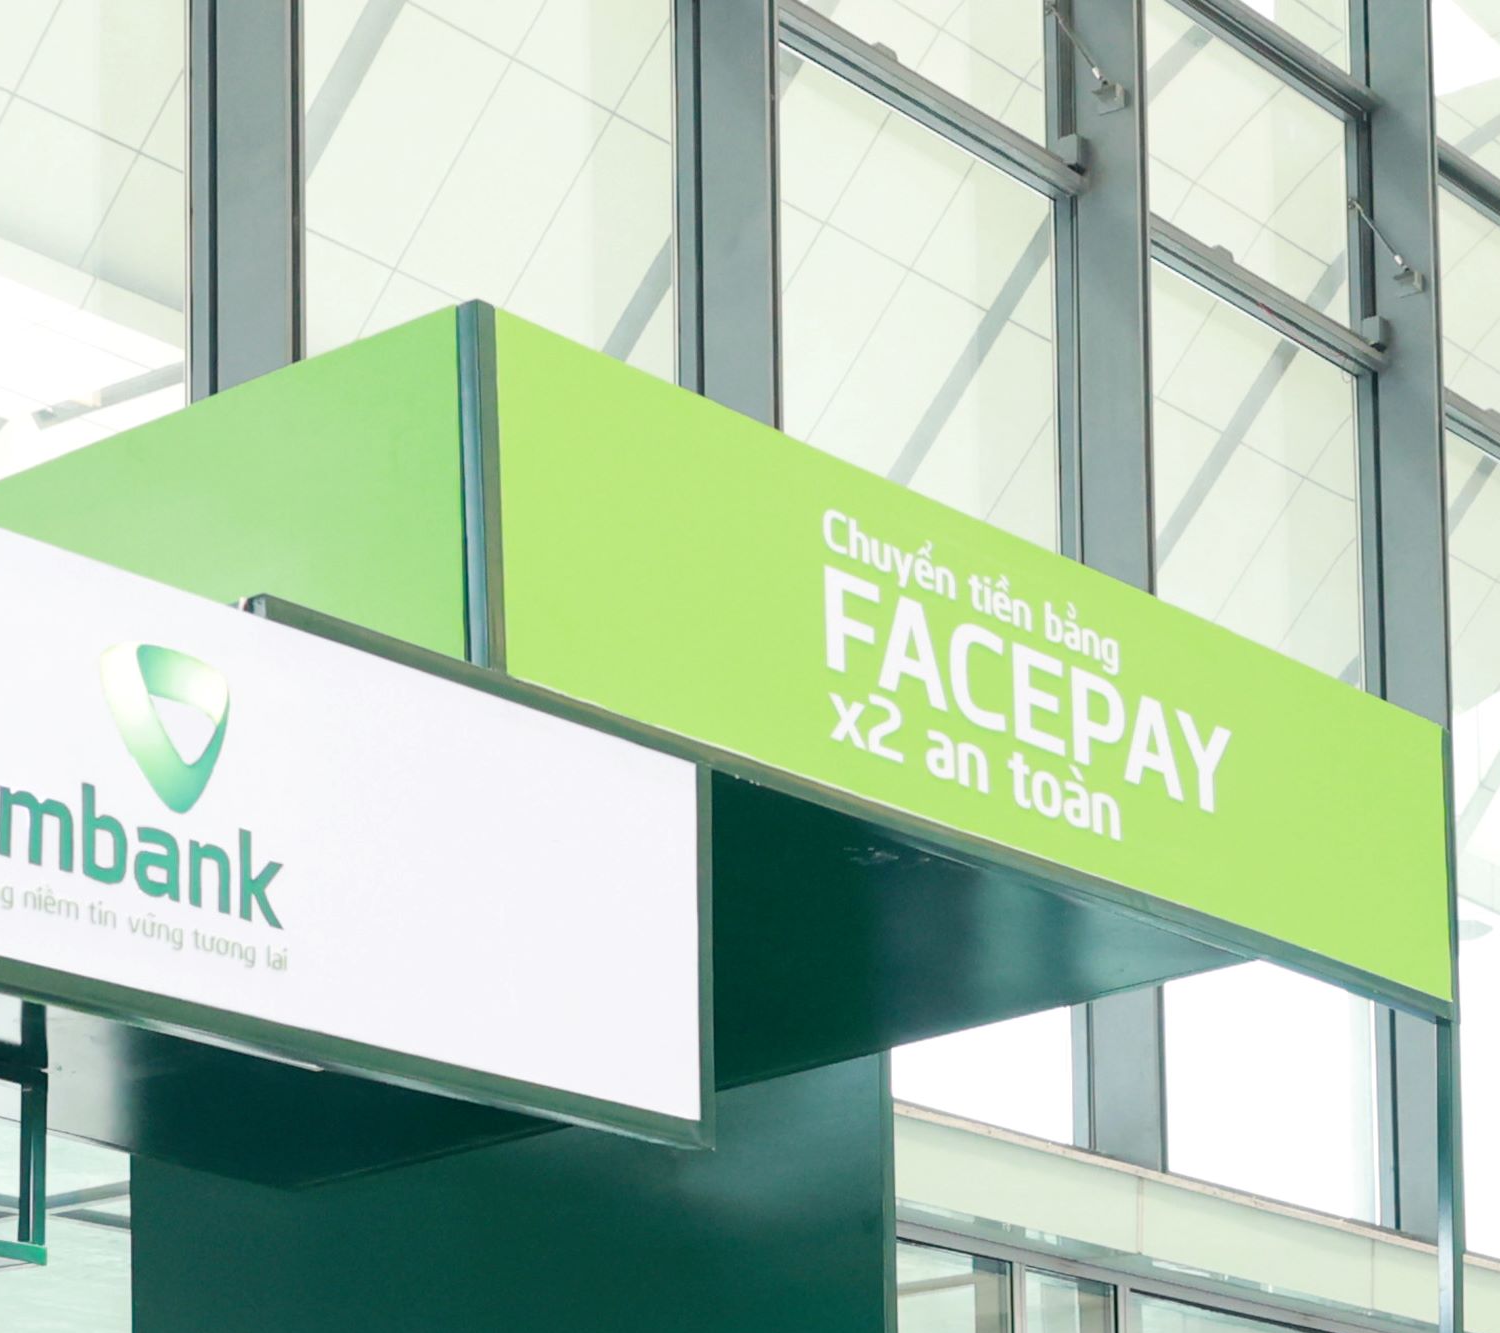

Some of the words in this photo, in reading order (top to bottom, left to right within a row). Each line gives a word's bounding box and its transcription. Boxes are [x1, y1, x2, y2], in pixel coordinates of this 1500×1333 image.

[822, 508, 958, 600] Chuyển
[968, 573, 1034, 632] tiền
[1044, 601, 1120, 676] bằng
[822, 564, 1233, 814] FACEPAY
[829, 691, 905, 765] x2
[926, 728, 990, 795] an
[1007, 751, 1123, 842] toàn
[22, 888, 80, 922] niềm
[89, 900, 118, 930] tin
[127, 912, 184, 951] vững
[192, 926, 257, 971] tương
[265, 944, 289, 972] lai
